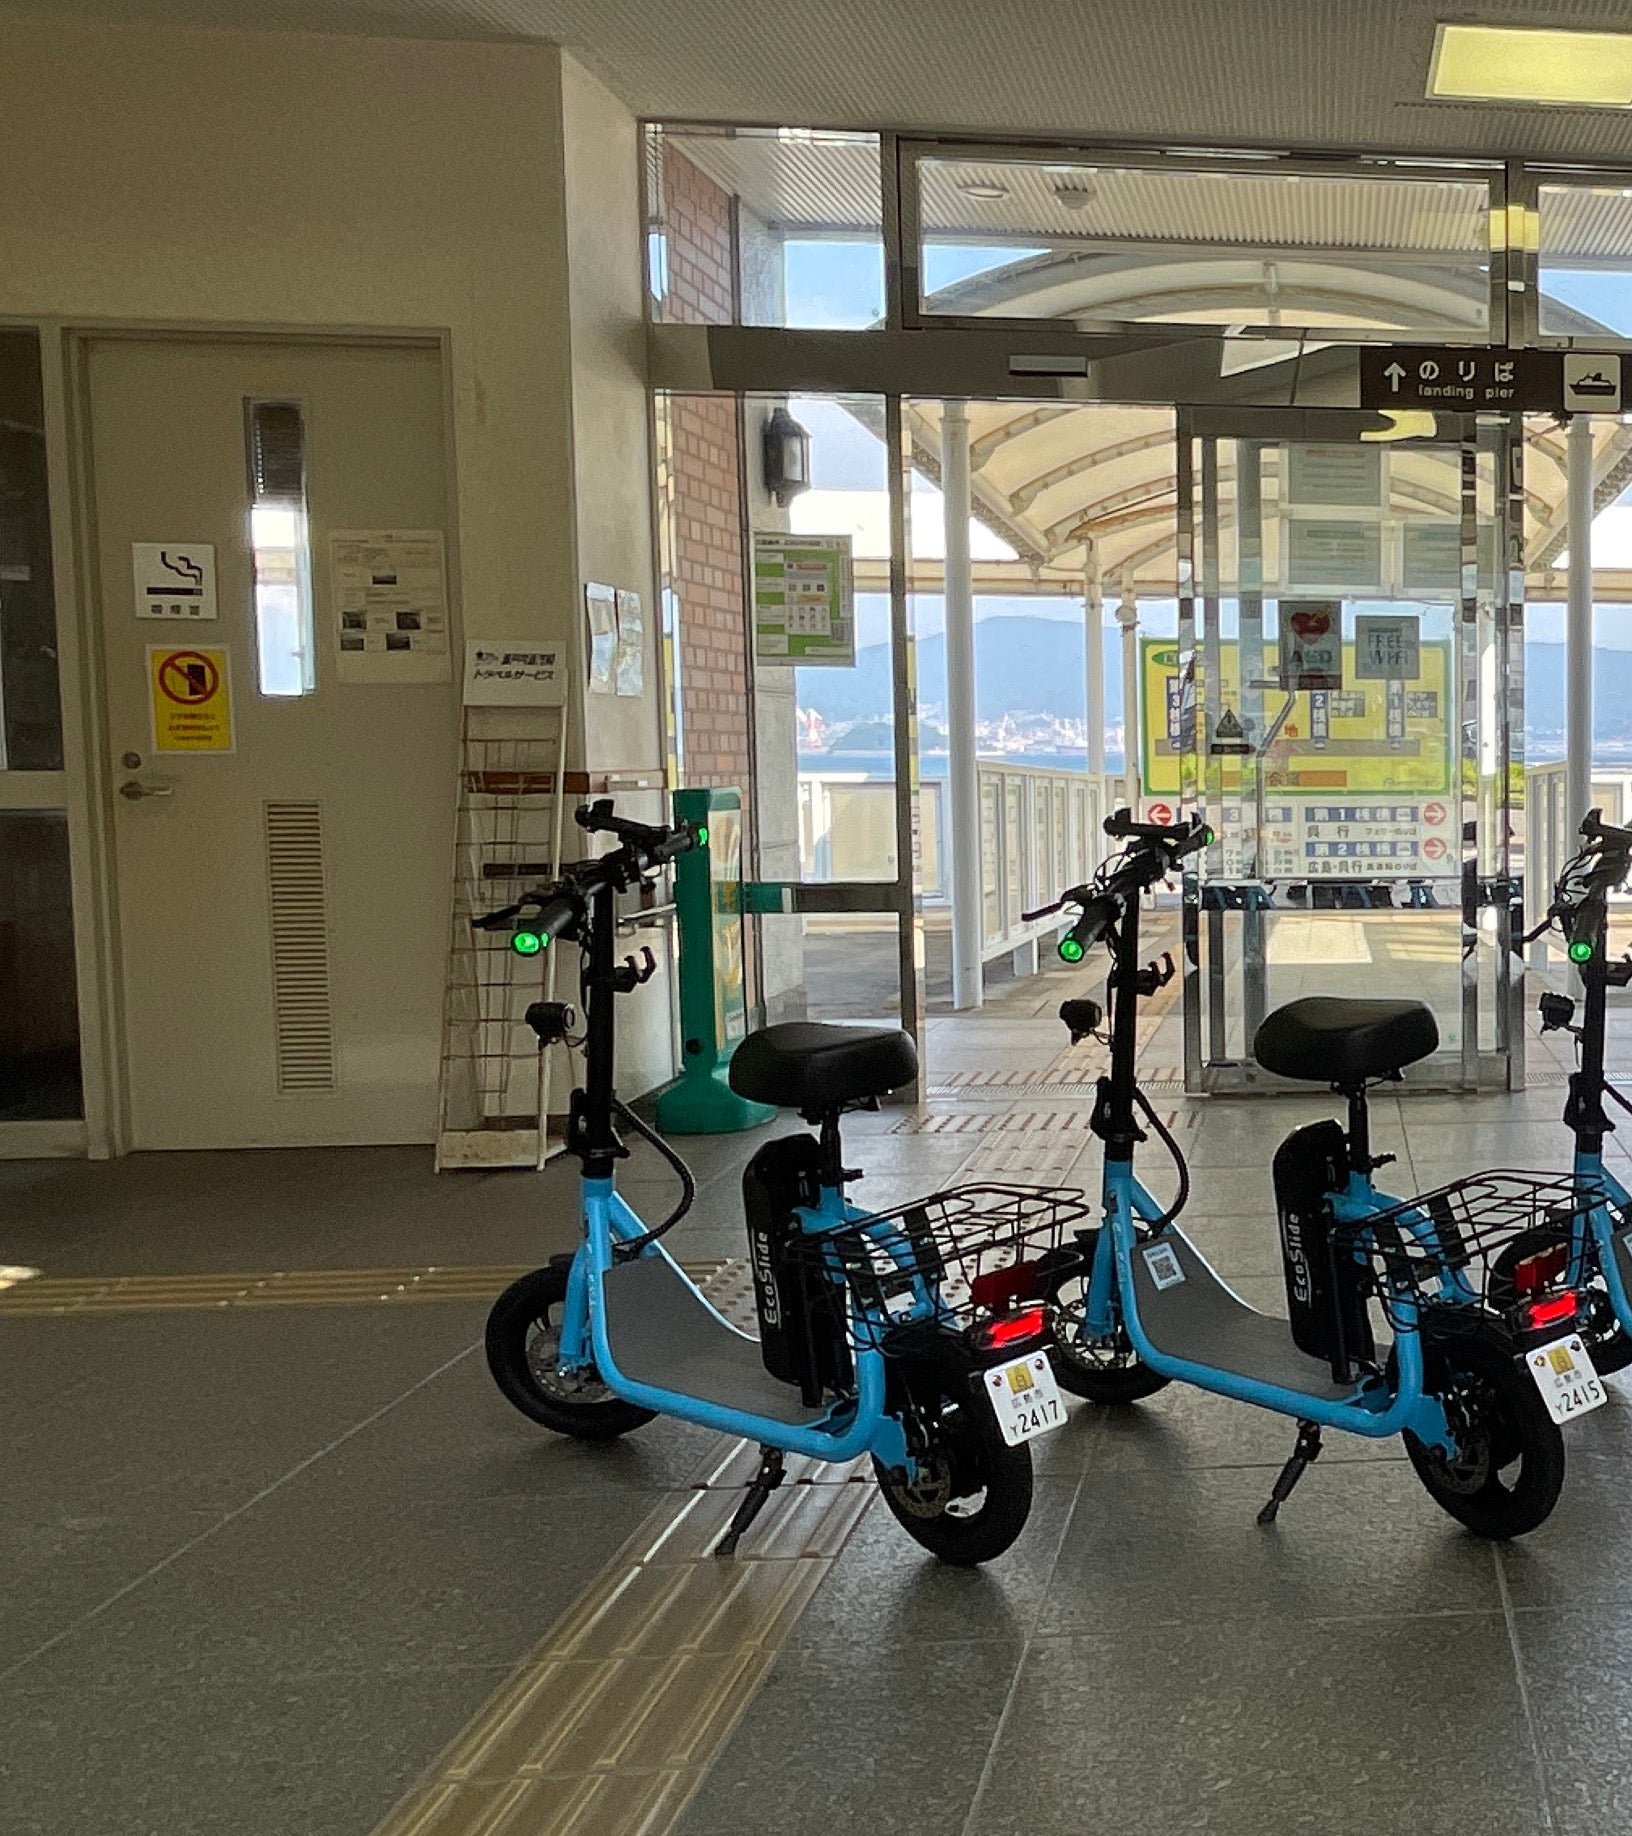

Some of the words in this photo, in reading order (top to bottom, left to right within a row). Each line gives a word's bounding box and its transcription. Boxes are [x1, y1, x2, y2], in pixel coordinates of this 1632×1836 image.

[1418, 361, 1515, 382] のりば
[1418, 384, 1474, 399] landing
[1485, 384, 1515, 399] pier
[1288, 1213, 1308, 1302] EcoSlide
[757, 1231, 778, 1325] EcoSlide
[1561, 1380, 1600, 1412] 2415
[1017, 1400, 1058, 1434] 2417
